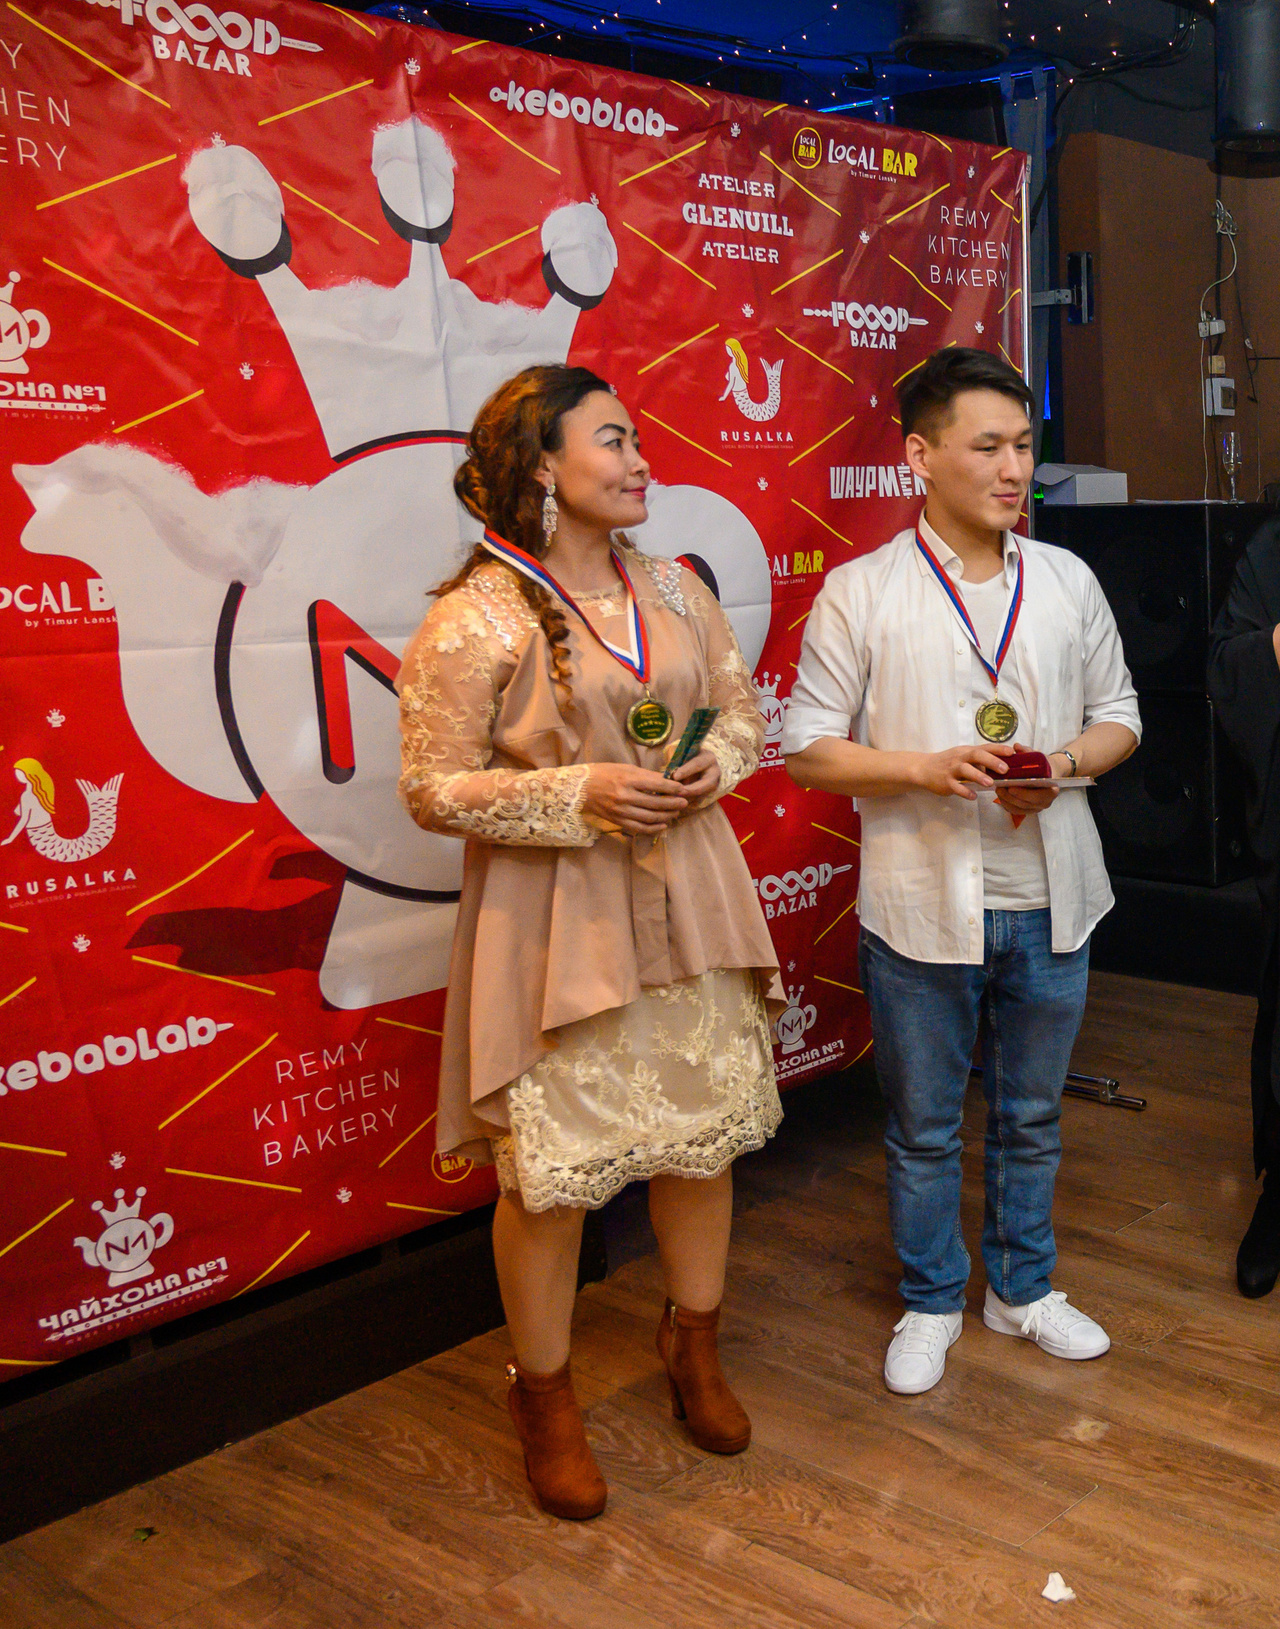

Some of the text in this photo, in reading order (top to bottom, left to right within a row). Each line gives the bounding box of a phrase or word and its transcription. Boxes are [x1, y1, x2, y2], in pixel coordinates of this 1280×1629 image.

[152, 34, 252, 77] BAZAR
[798, 144, 817, 159] BAR
[800, 134, 816, 146] LOCAL
[828, 138, 918, 177] LOCAL BAR
[698, 173, 776, 198] ATELIER
[859, 171, 876, 180] Timur
[682, 202, 794, 237] GLENUILL
[940, 205, 991, 230] REMY
[702, 241, 779, 264] ATELIER
[928, 234, 1010, 261] KITCHEN
[930, 265, 1008, 288] BAKERY
[850, 330, 897, 350] BAZAR
[5, 411, 35, 419] imur
[720, 431, 794, 442] RUSALKA
[793, 549, 824, 575] BAR
[0, 581, 82, 614] OCAL
[25, 618, 39, 628] by
[84, 615, 118, 624] Lansk
[6, 868, 137, 899] RUSALKA
[765, 891, 818, 920] BAZAR
[275, 1038, 368, 1084] REMY
[774, 1048, 821, 1073] ХОНА
[253, 1067, 400, 1131] KITCHEN
[263, 1104, 398, 1167] BAKERY
[440, 1156, 468, 1174] BAR
[38, 1273, 182, 1330] ЧАЙХОНА
